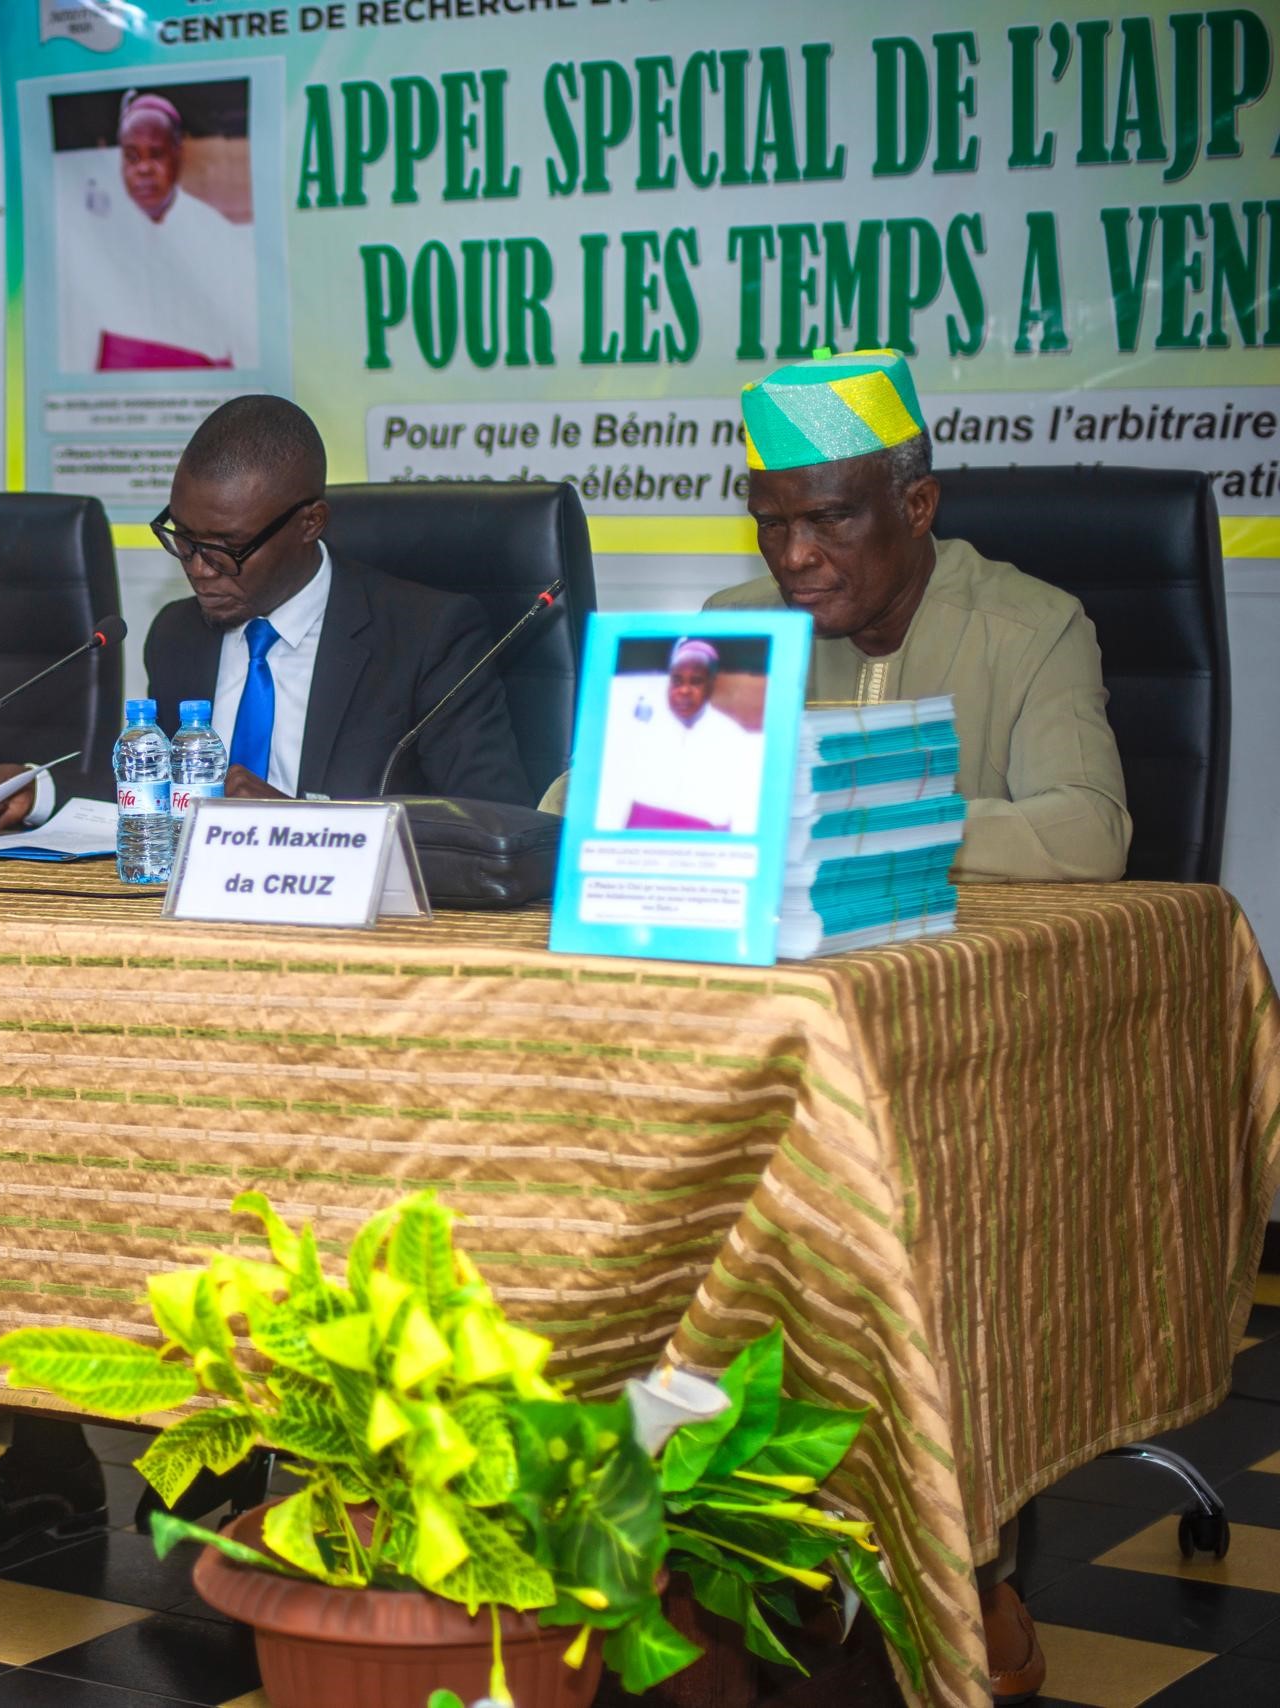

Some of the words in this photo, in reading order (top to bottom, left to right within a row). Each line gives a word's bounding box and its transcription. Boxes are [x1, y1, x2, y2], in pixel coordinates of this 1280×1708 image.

[159, 9, 288, 44] CENTRE
[300, 5, 346, 31] DE
[297, 69, 521, 210] APPEL
[544, 42, 846, 198] SPECIAL
[872, 31, 980, 178] DE
[1008, 9, 1272, 184] L’IAJP
[360, 237, 556, 371] POUR
[580, 227, 701, 365] LES
[728, 212, 986, 361] TEMPS
[1015, 211, 1070, 354] A
[384, 416, 467, 450] Pour
[474, 422, 540, 457] que
[551, 414, 582, 449] le
[593, 412, 699, 448] Bénin
[934, 407, 1035, 444] dans
[1049, 402, 1278, 442] l’arbitraire
[205, 825, 260, 847] Prof.
[269, 826, 368, 849] Maxime
[224, 872, 255, 894] da
[262, 874, 336, 896] CRUZ
